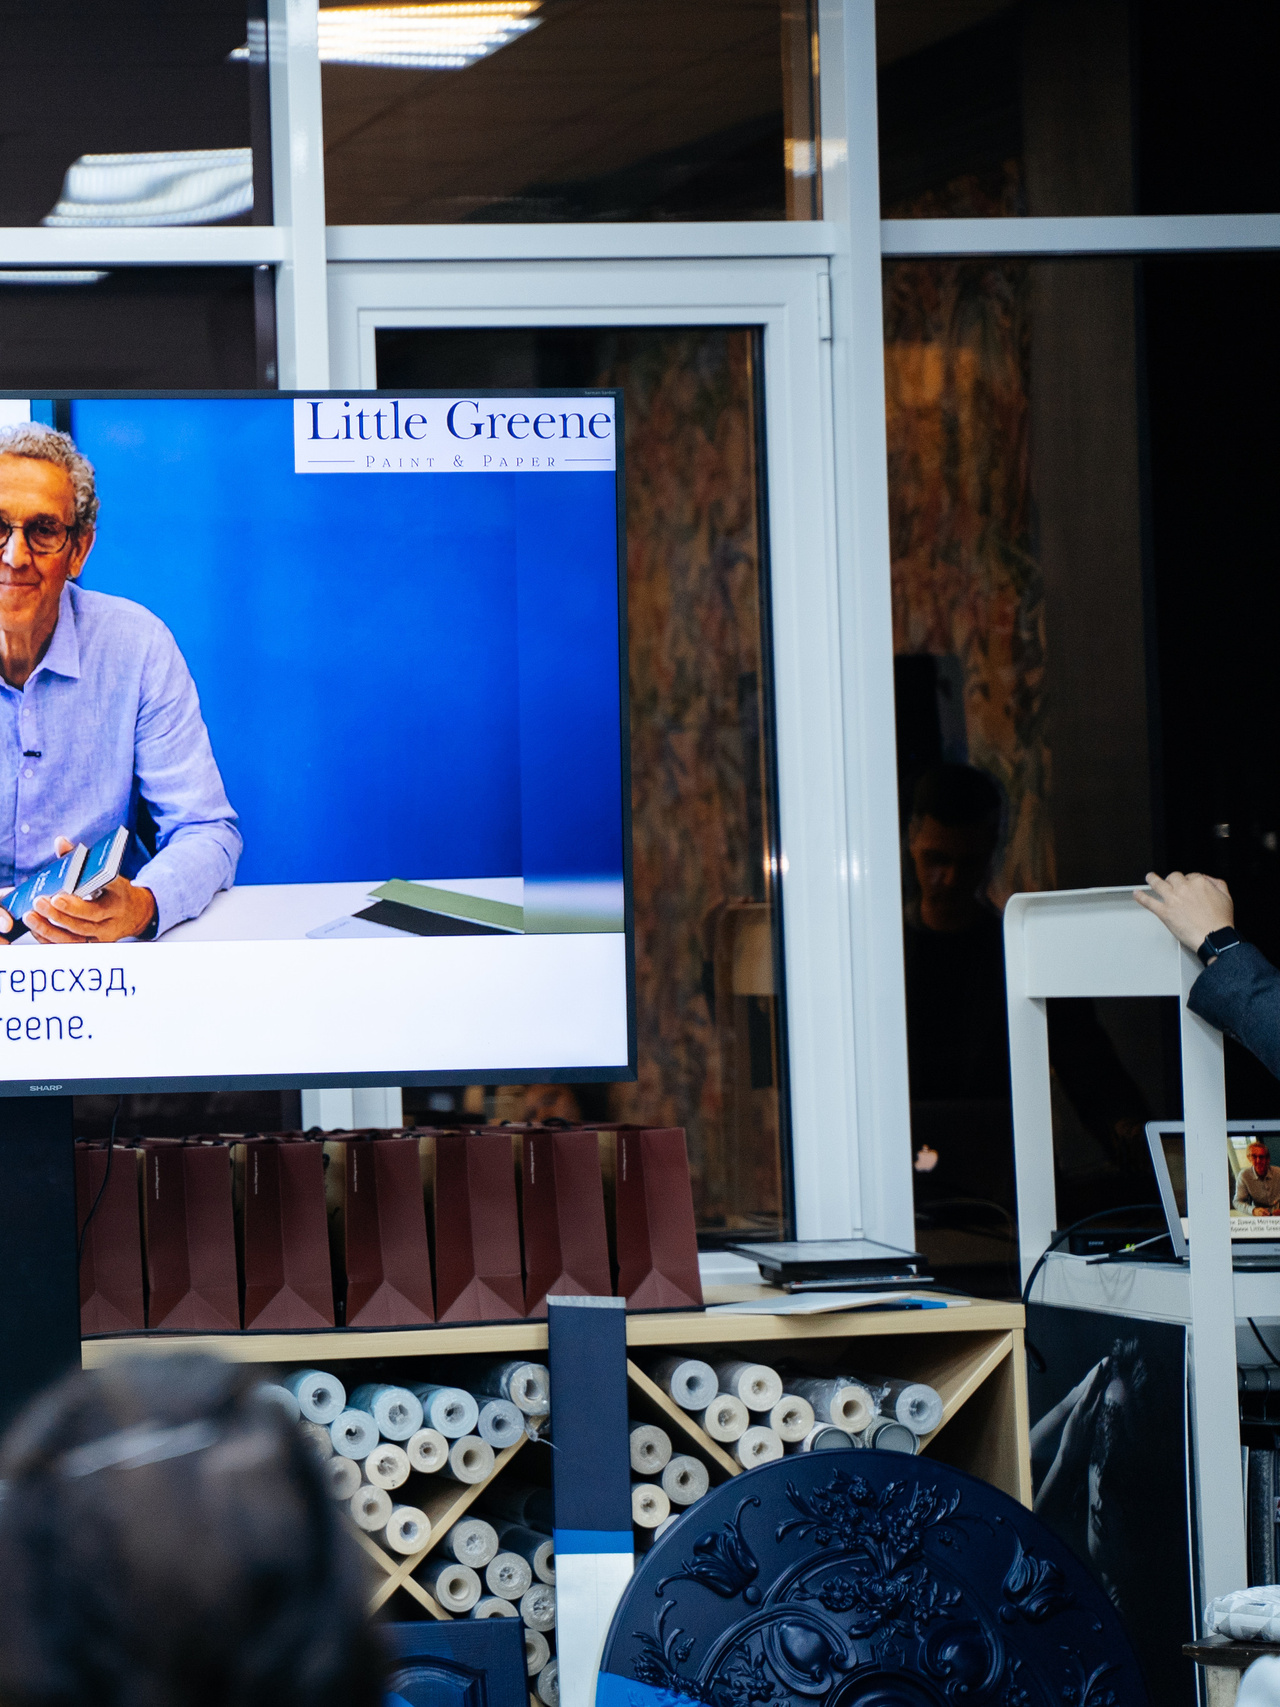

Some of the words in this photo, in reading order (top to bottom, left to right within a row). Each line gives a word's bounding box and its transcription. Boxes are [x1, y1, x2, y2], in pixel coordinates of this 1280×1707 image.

[306, 400, 428, 441] Little
[446, 400, 612, 440] Greene
[365, 455, 435, 468] PAINT
[453, 455, 464, 467] &
[483, 454, 556, 467] PAPER
[29, 1084, 63, 1092] SHARP
